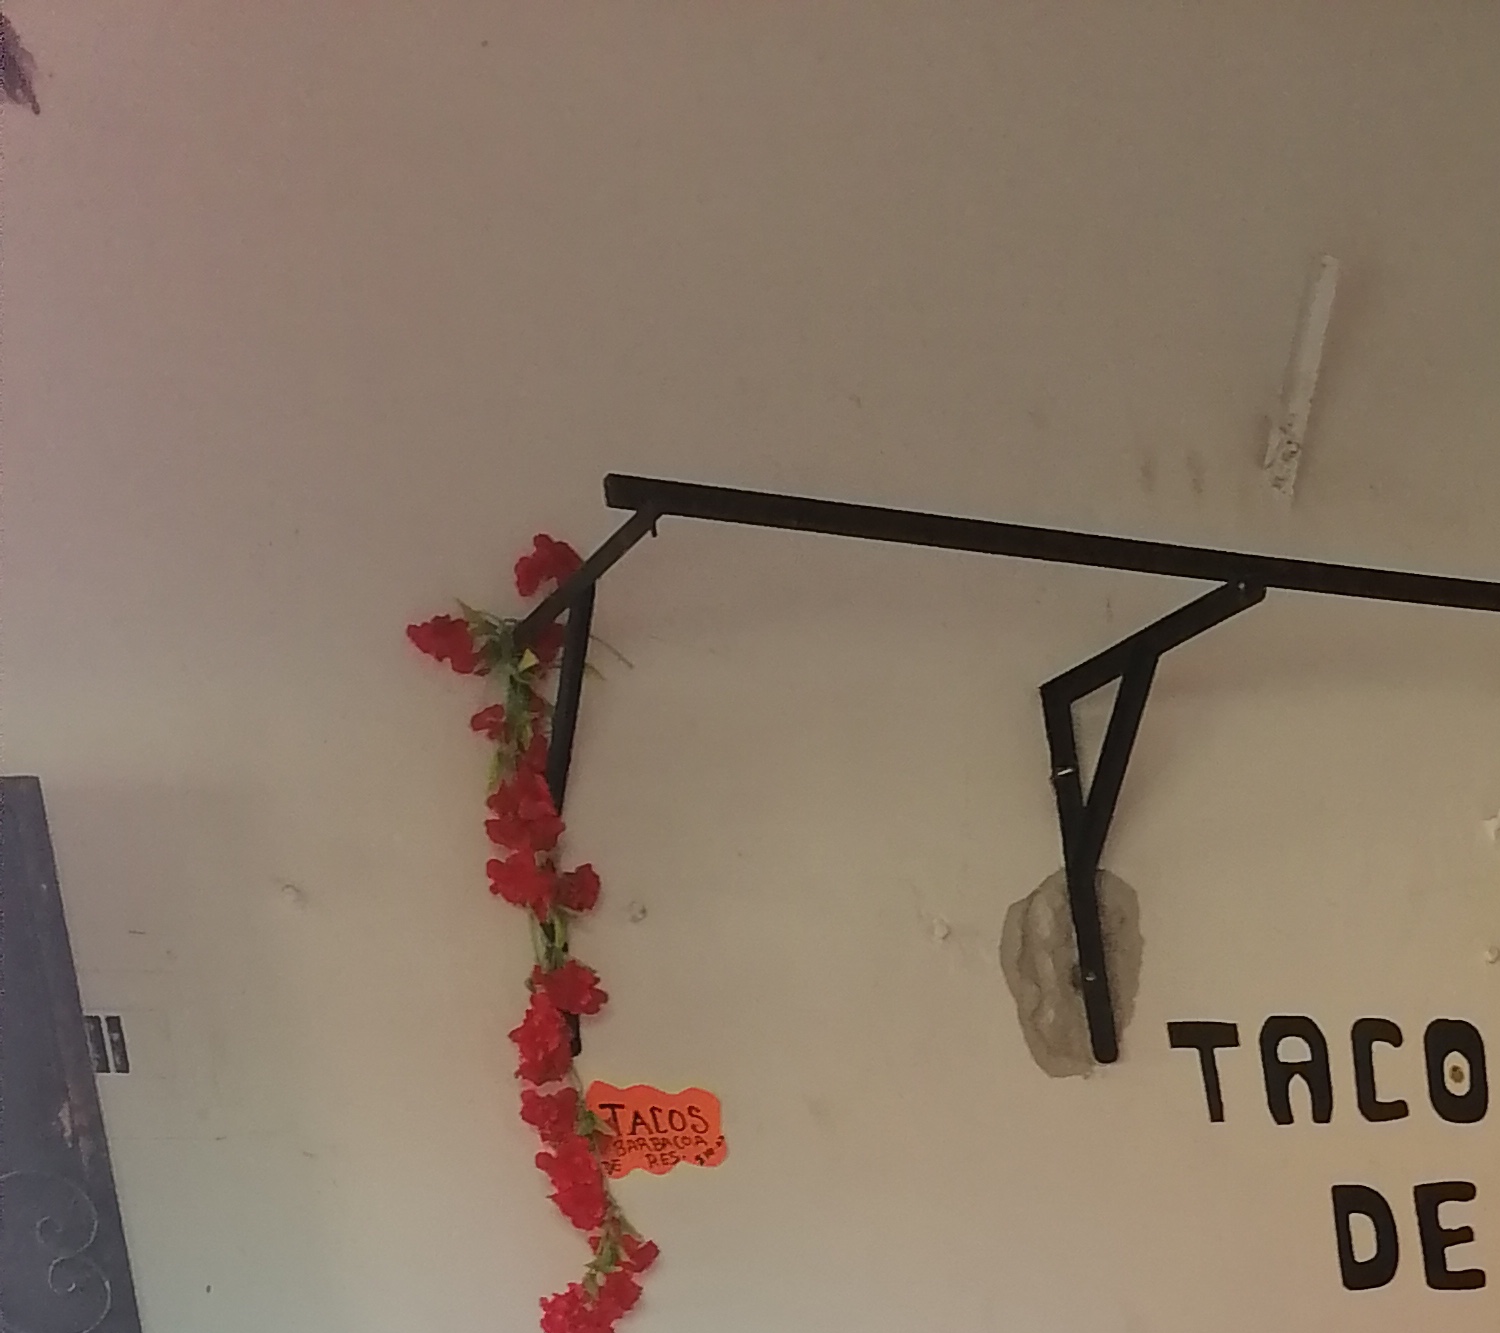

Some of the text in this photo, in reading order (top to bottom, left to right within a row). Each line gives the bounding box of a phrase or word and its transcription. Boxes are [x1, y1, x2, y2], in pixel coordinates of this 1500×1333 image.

[598, 1103, 709, 1136] TACOS
[613, 1135, 708, 1157] BARBACOA
[1331, 1181, 1487, 1291] DE
